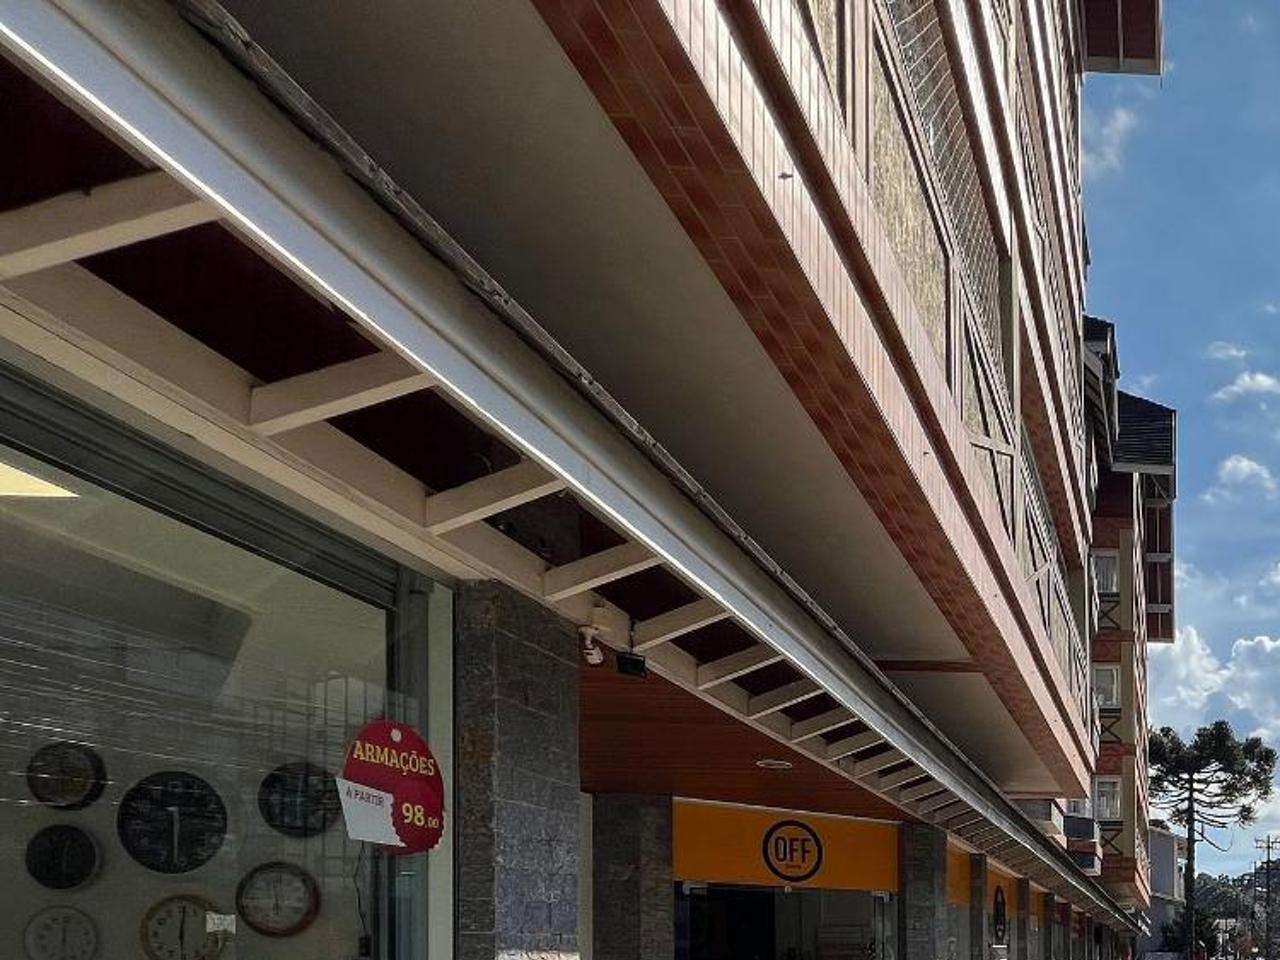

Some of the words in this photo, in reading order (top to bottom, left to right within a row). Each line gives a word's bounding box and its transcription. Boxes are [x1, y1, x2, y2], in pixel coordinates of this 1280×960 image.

[353, 740, 435, 776] ARMAÇÕES
[346, 786, 352, 799] A
[774, 836, 812, 863] OFF
